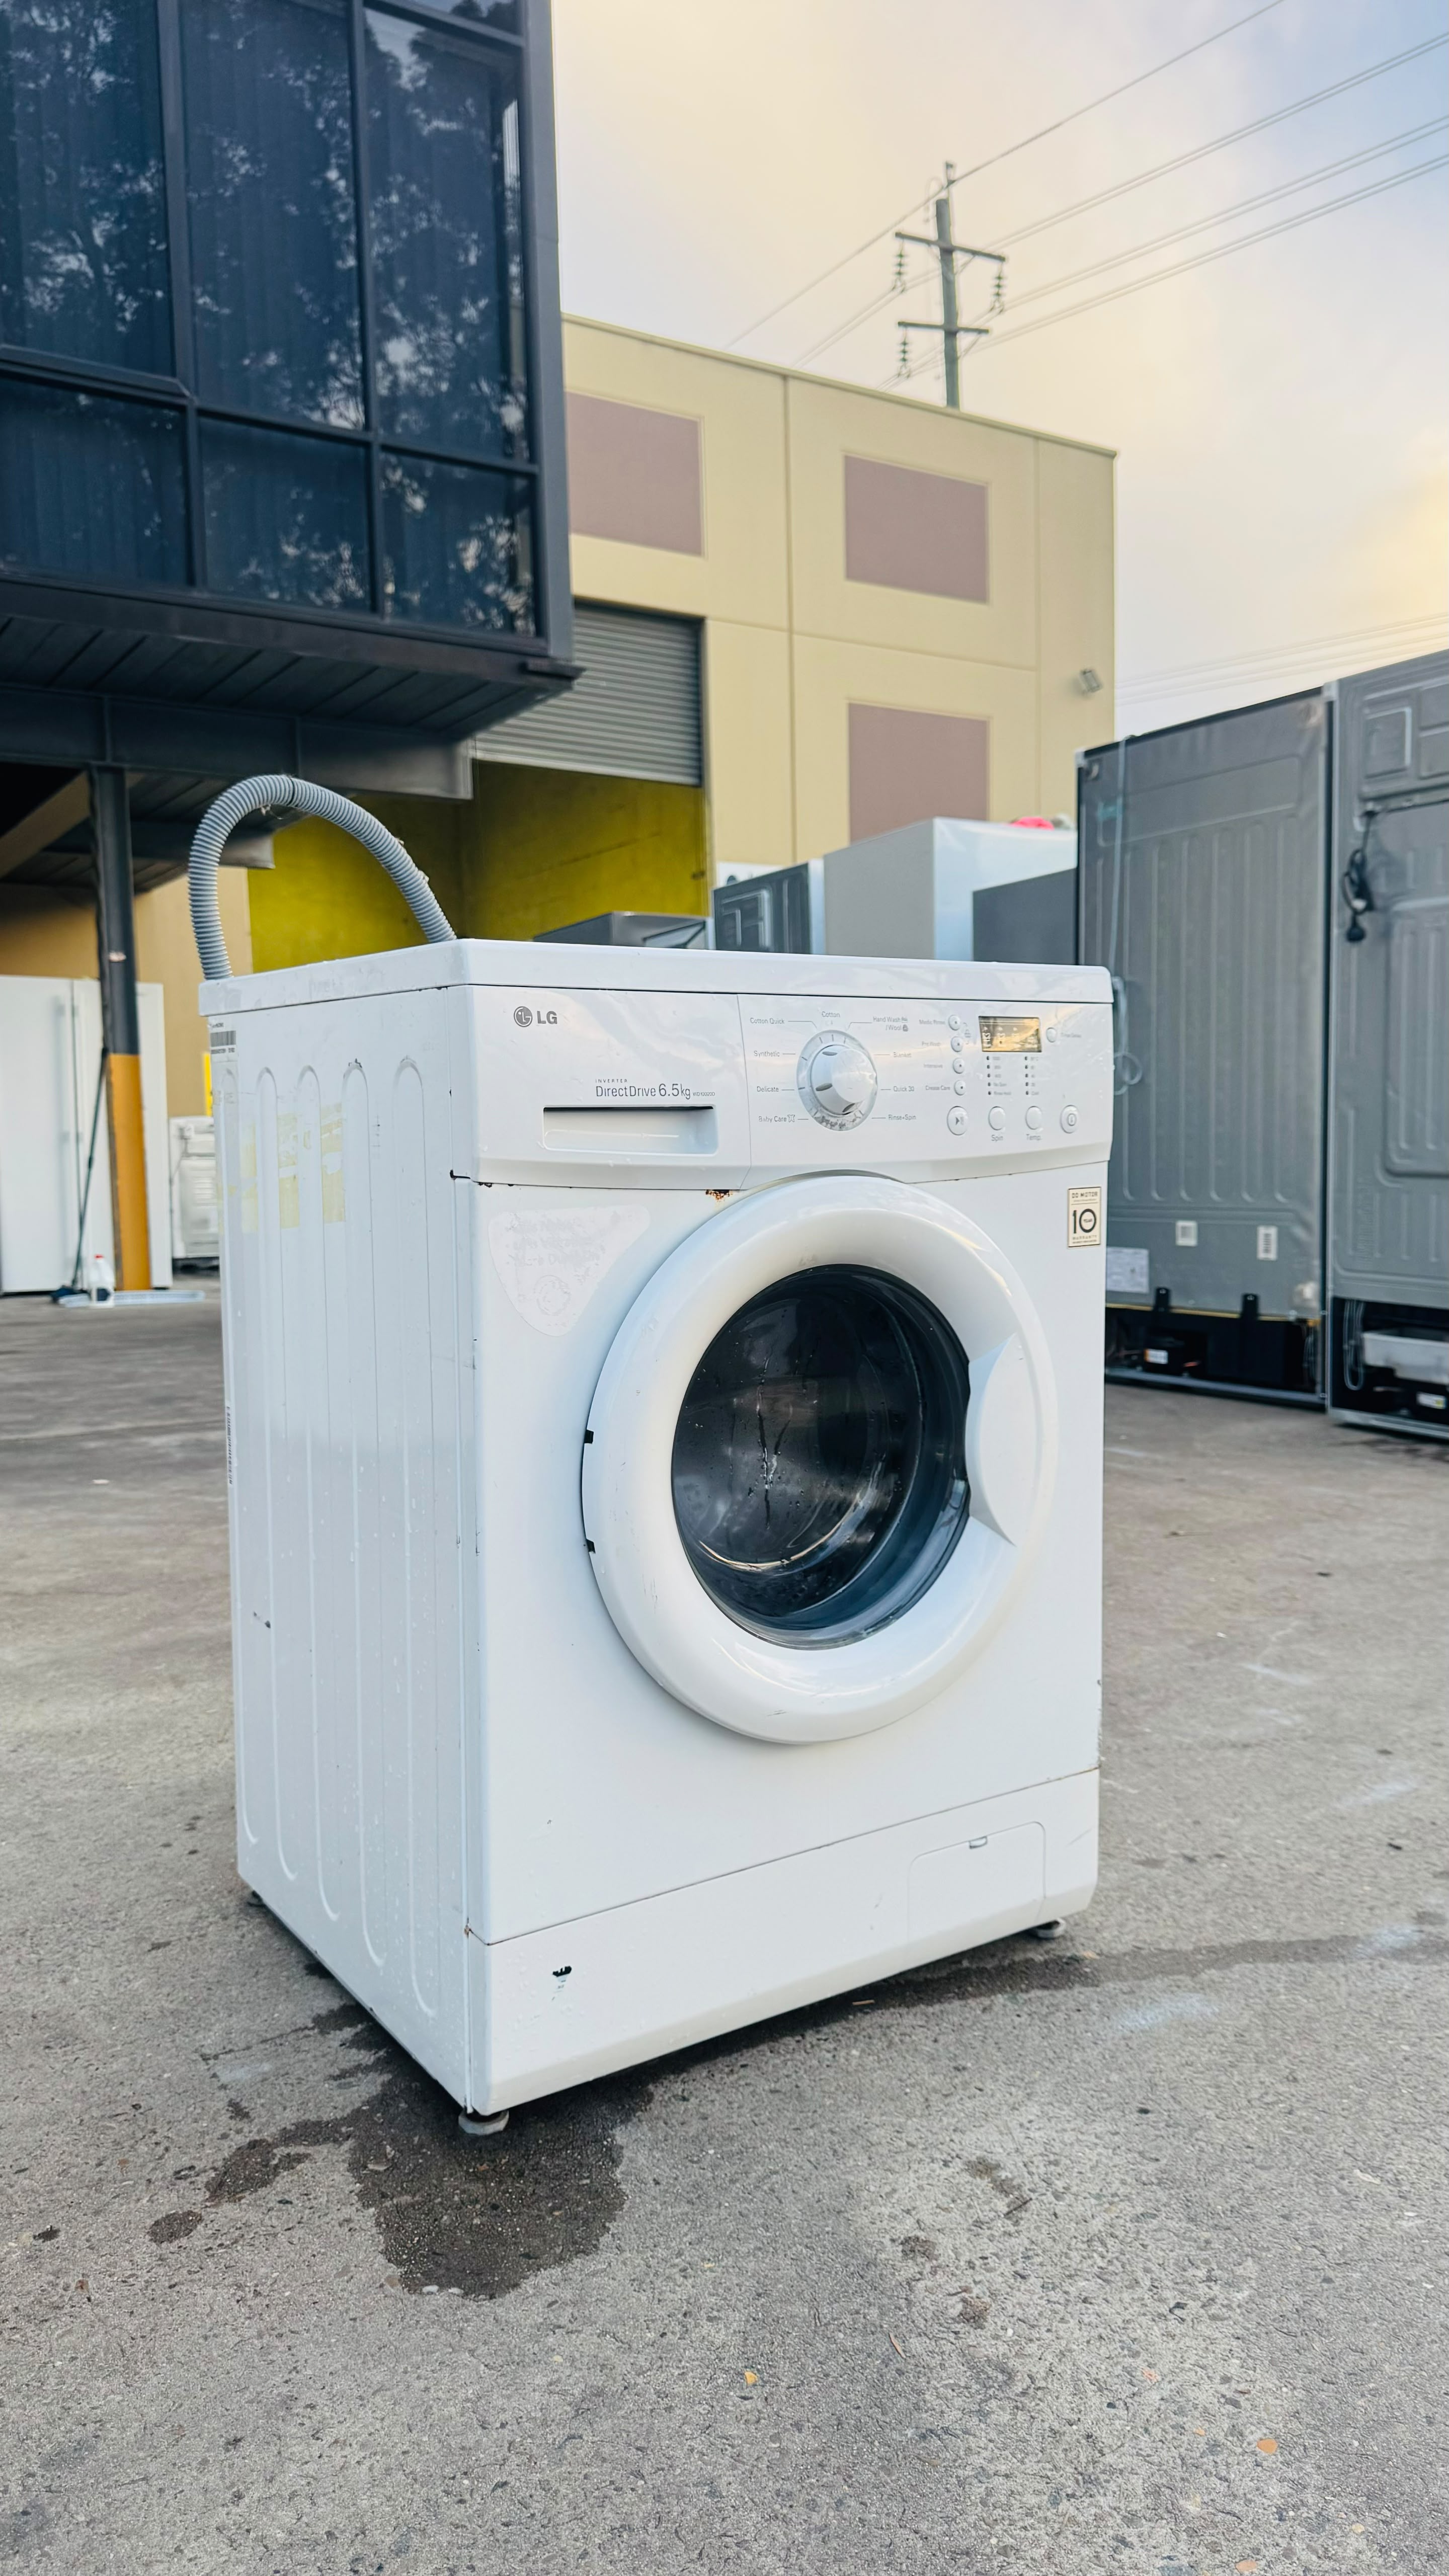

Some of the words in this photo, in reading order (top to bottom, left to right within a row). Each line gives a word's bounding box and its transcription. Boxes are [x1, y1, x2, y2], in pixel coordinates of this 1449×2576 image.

[537, 1011, 557, 1024] LG
[659, 1083, 691, 1099] 6.5kg
[991, 1134, 1004, 1142] Spin
[1072, 1209, 1097, 1234] 10
